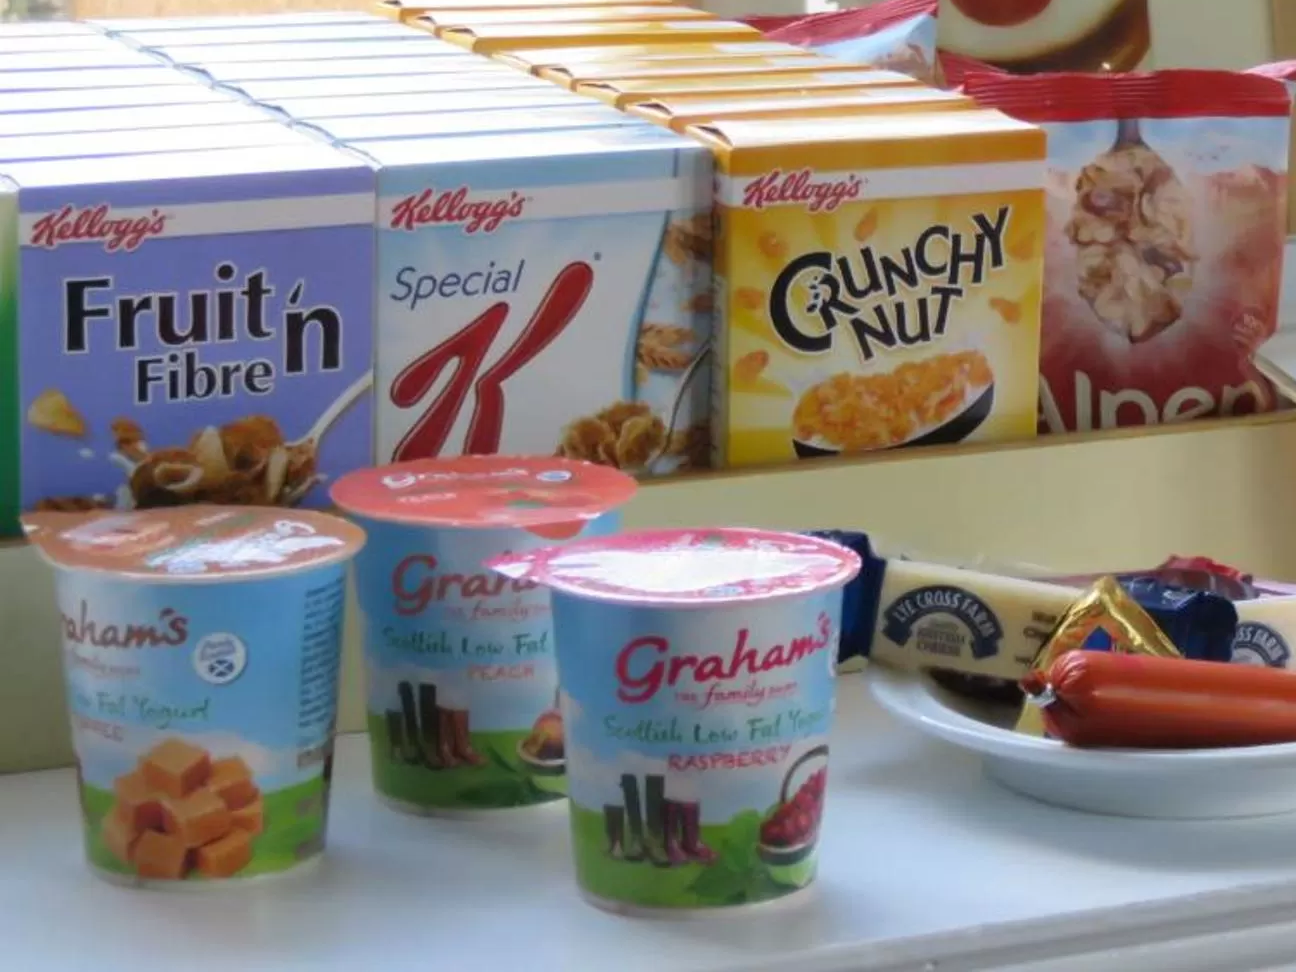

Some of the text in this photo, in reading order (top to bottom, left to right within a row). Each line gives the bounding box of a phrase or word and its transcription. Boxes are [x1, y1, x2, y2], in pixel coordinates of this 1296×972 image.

[391, 186, 526, 232] Kellogg's
[742, 169, 863, 216] Kellogg's
[31, 205, 167, 253] Kellogg's
[63, 261, 274, 353] Fruit
[390, 259, 525, 309] Special
[849, 285, 963, 360] NUT
[135, 351, 273, 404] Fibre
[389, 259, 594, 461] K
[915, 591, 961, 608] CROSS
[615, 611, 833, 704] Graham's
[667, 743, 792, 773] RASPBERRY
